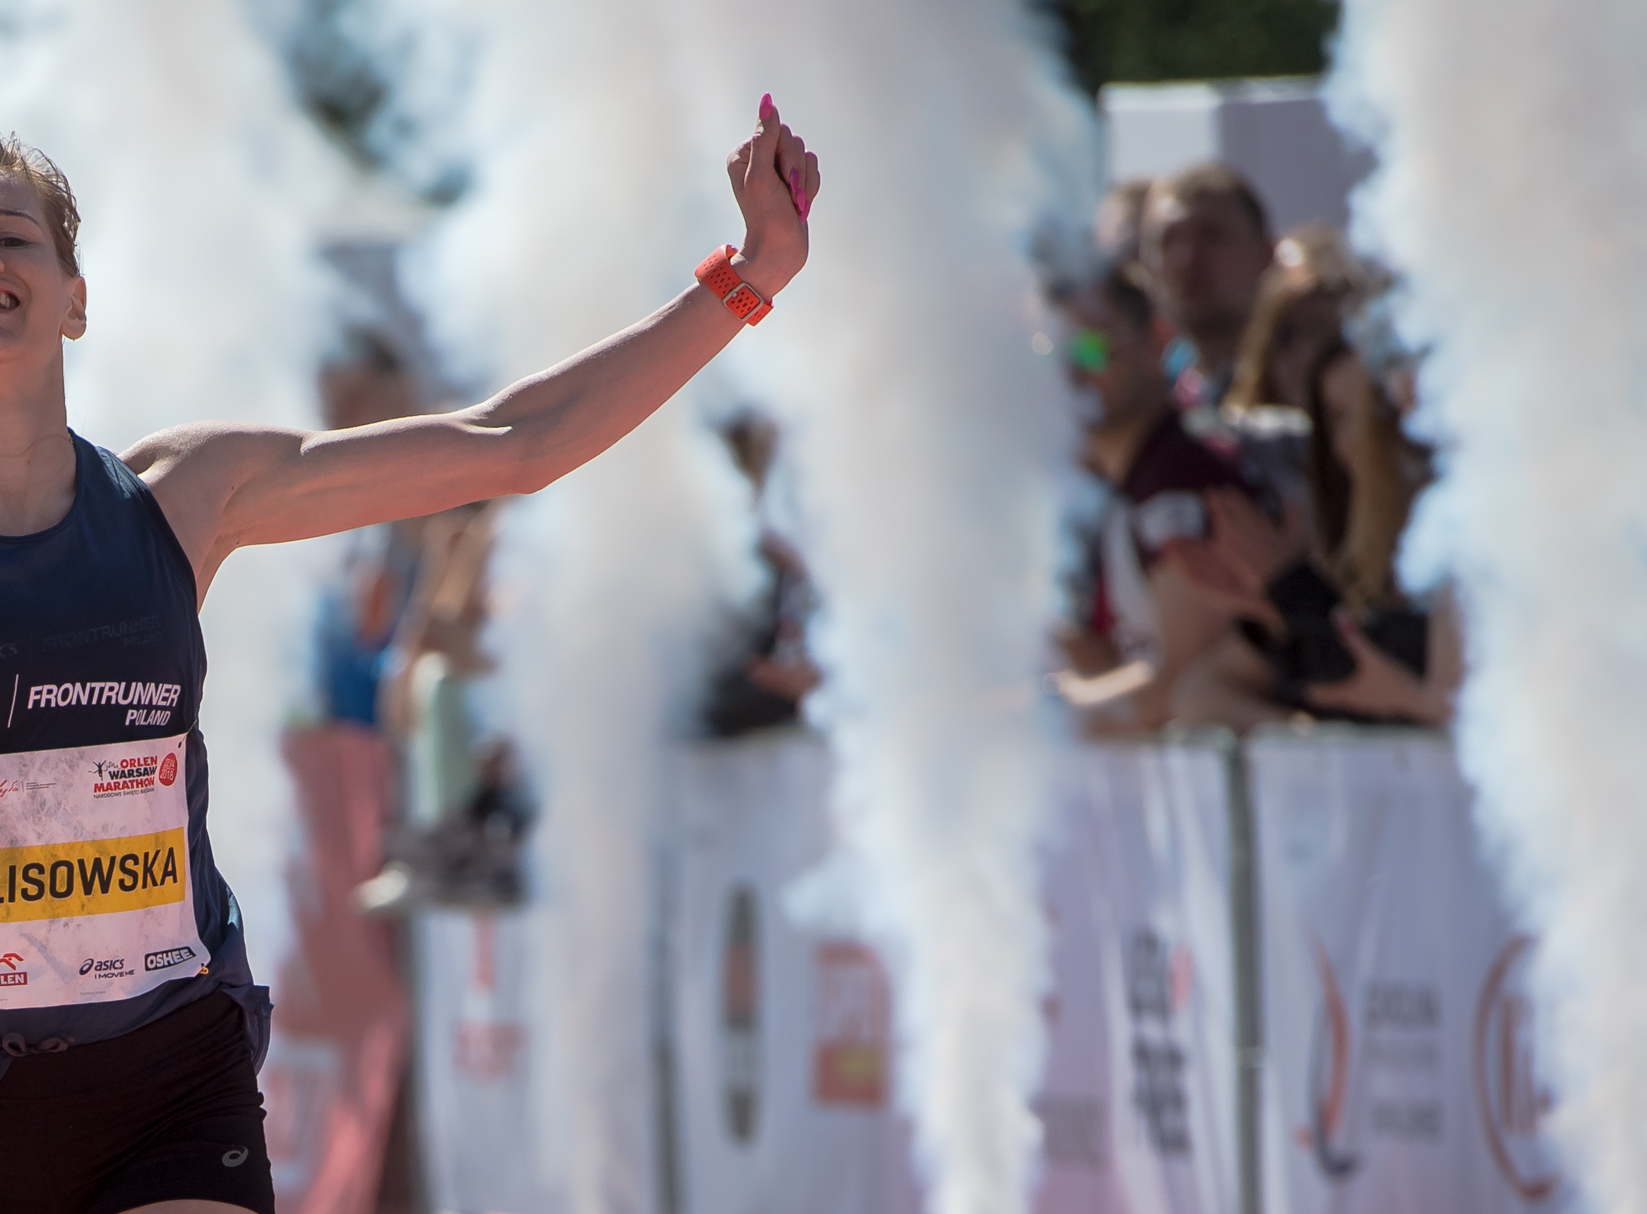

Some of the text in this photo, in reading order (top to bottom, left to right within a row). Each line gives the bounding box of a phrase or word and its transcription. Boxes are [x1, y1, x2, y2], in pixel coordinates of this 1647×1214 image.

[27, 682, 181, 709] FRONTRUNNER
[125, 709, 171, 726] POLAND
[120, 756, 158, 769] ORLEN
[108, 766, 158, 780] WARSAW
[93, 776, 156, 793] MARATHON
[94, 958, 124, 971] asics
[146, 948, 193, 969] OSHEE
